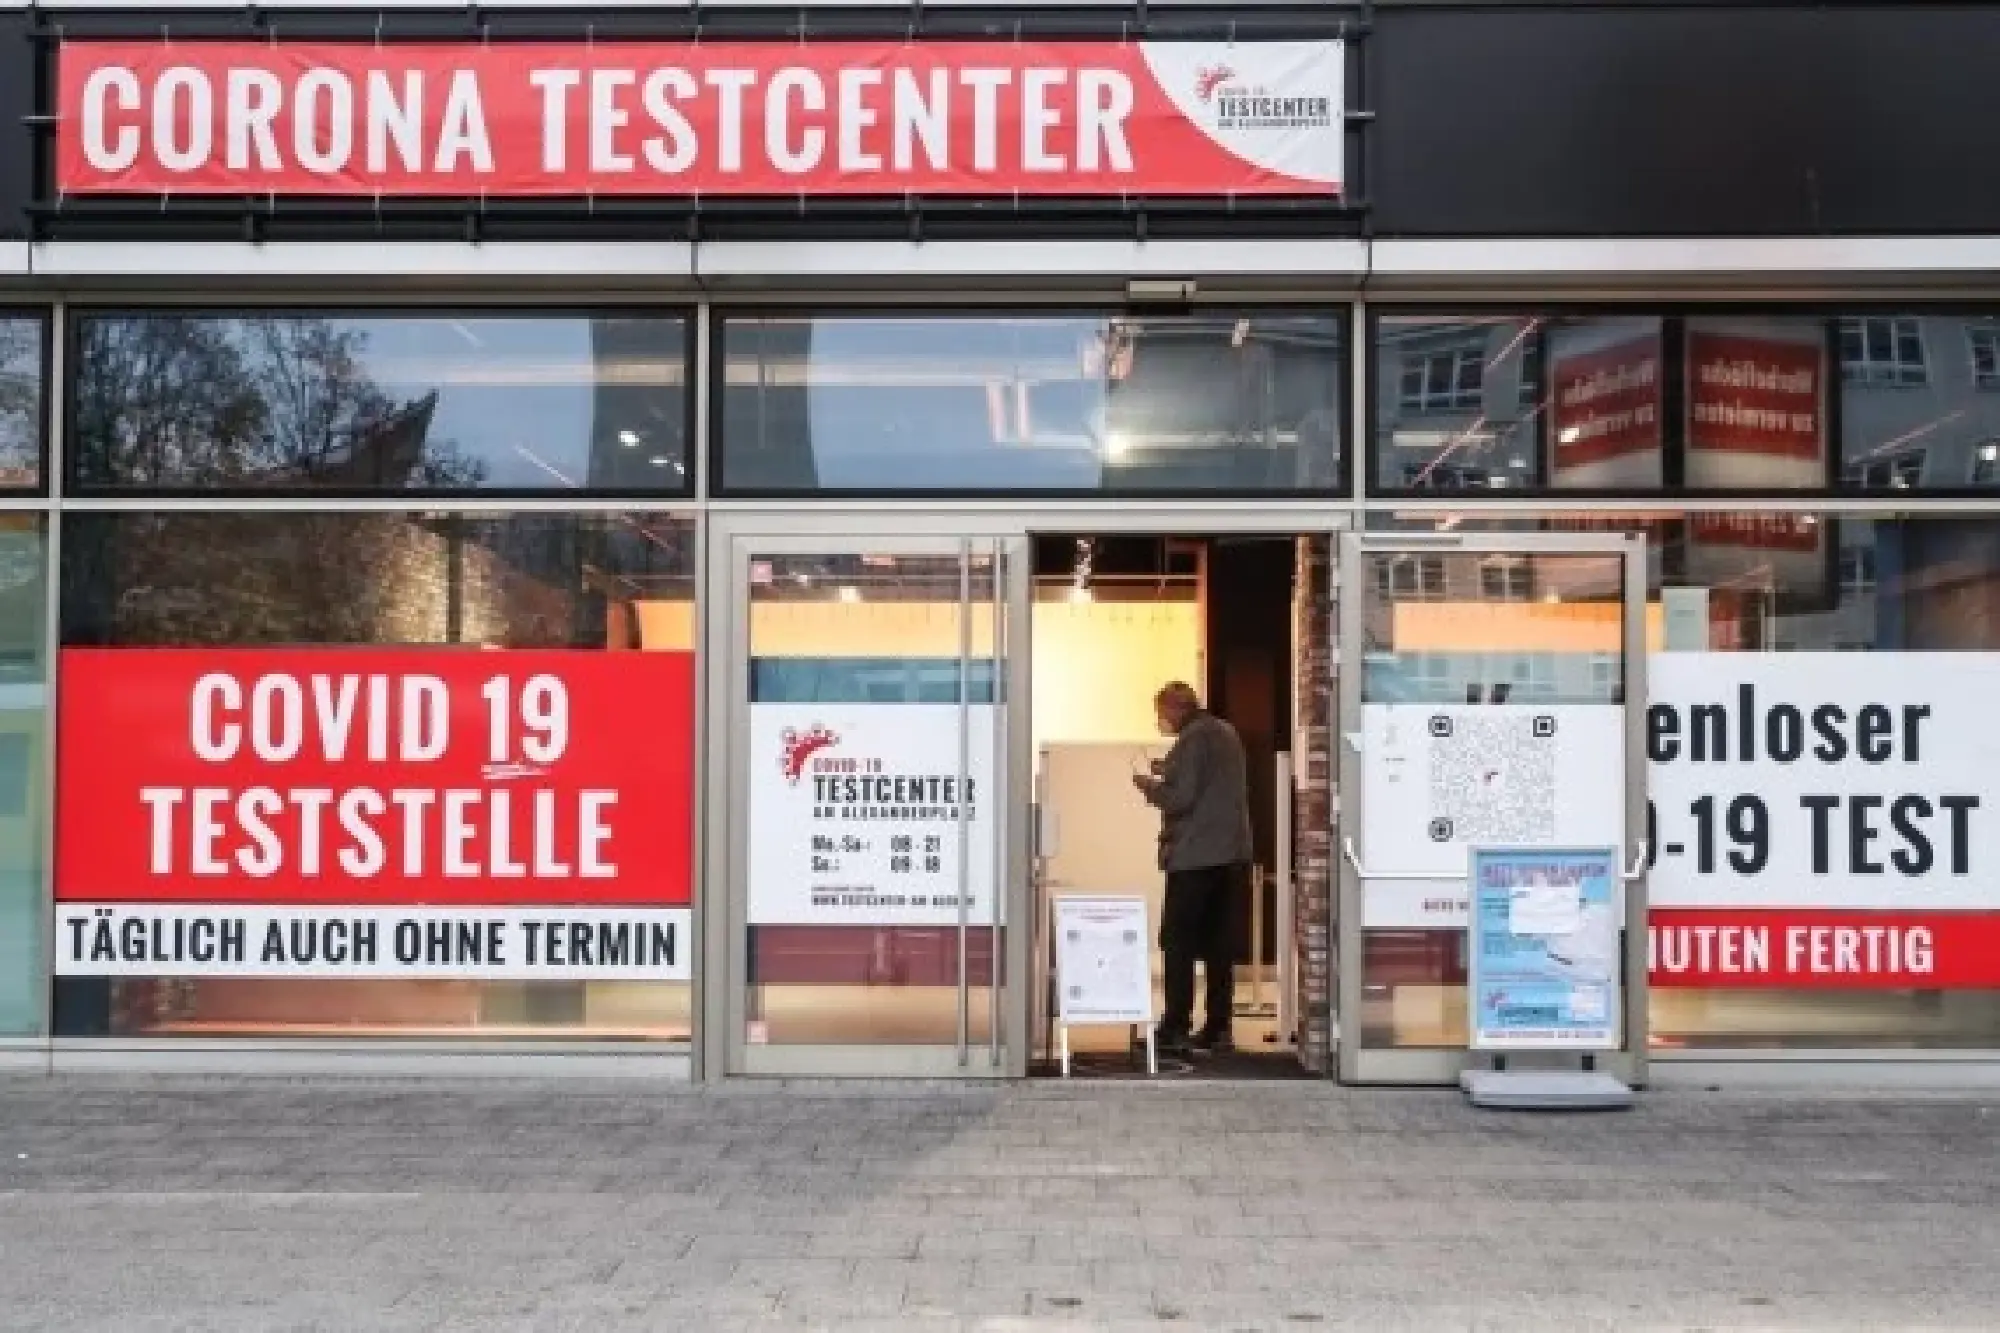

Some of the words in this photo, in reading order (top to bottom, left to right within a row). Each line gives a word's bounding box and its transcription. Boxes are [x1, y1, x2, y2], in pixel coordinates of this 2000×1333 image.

[82, 66, 495, 174] CORONA
[529, 66, 1135, 174] TESTCENTER
[1217, 97, 1329, 117] TESTCENTER
[191, 672, 450, 763] COVID
[482, 674, 569, 763] 19
[813, 775, 976, 804] TESTCENTER
[141, 786, 618, 878] TESTSTELLE
[1648, 795, 1770, 875] -19
[1799, 794, 1980, 875] TEST
[67, 909, 244, 963] TÄGLICH
[261, 918, 376, 964] AUCH
[394, 919, 505, 965] OHNE
[523, 922, 675, 966] TERMIN
[1785, 926, 1933, 973] FERTIG
